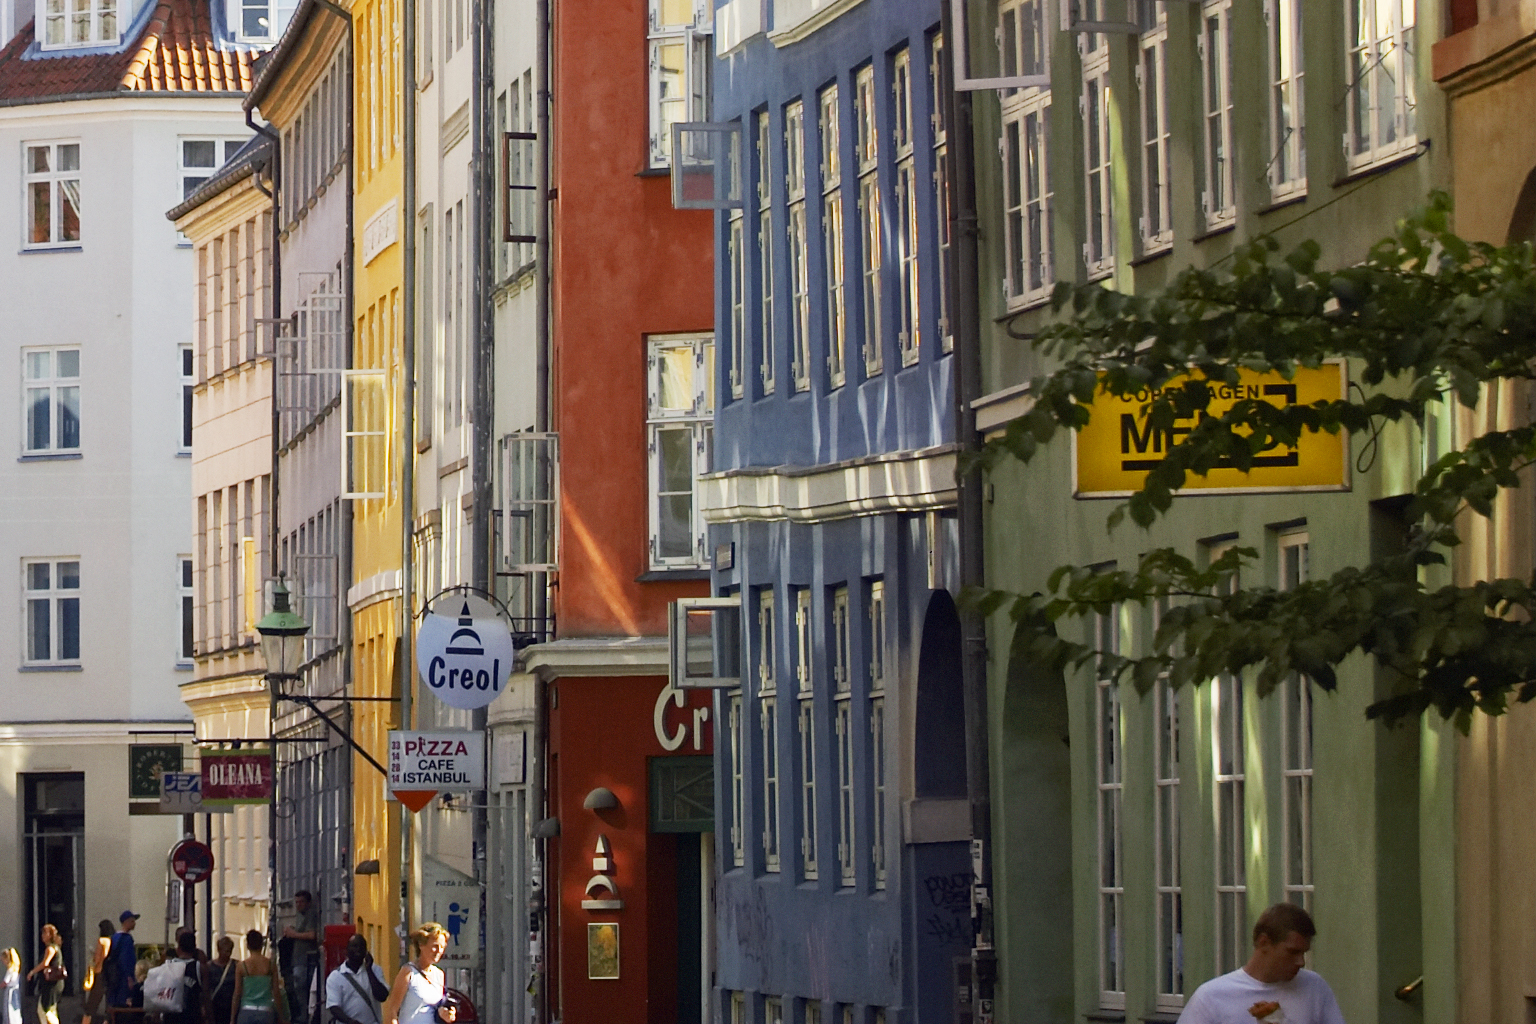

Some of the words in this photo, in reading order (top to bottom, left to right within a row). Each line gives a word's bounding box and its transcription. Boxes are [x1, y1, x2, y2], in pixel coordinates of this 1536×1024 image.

[1120, 384, 1260, 403] COPEAGEN
[428, 655, 499, 692] Creol
[405, 737, 468, 756] PIZZA
[418, 759, 454, 770] CAFE
[209, 763, 263, 786] OLEANA
[403, 772, 471, 783] ISTANBUL
